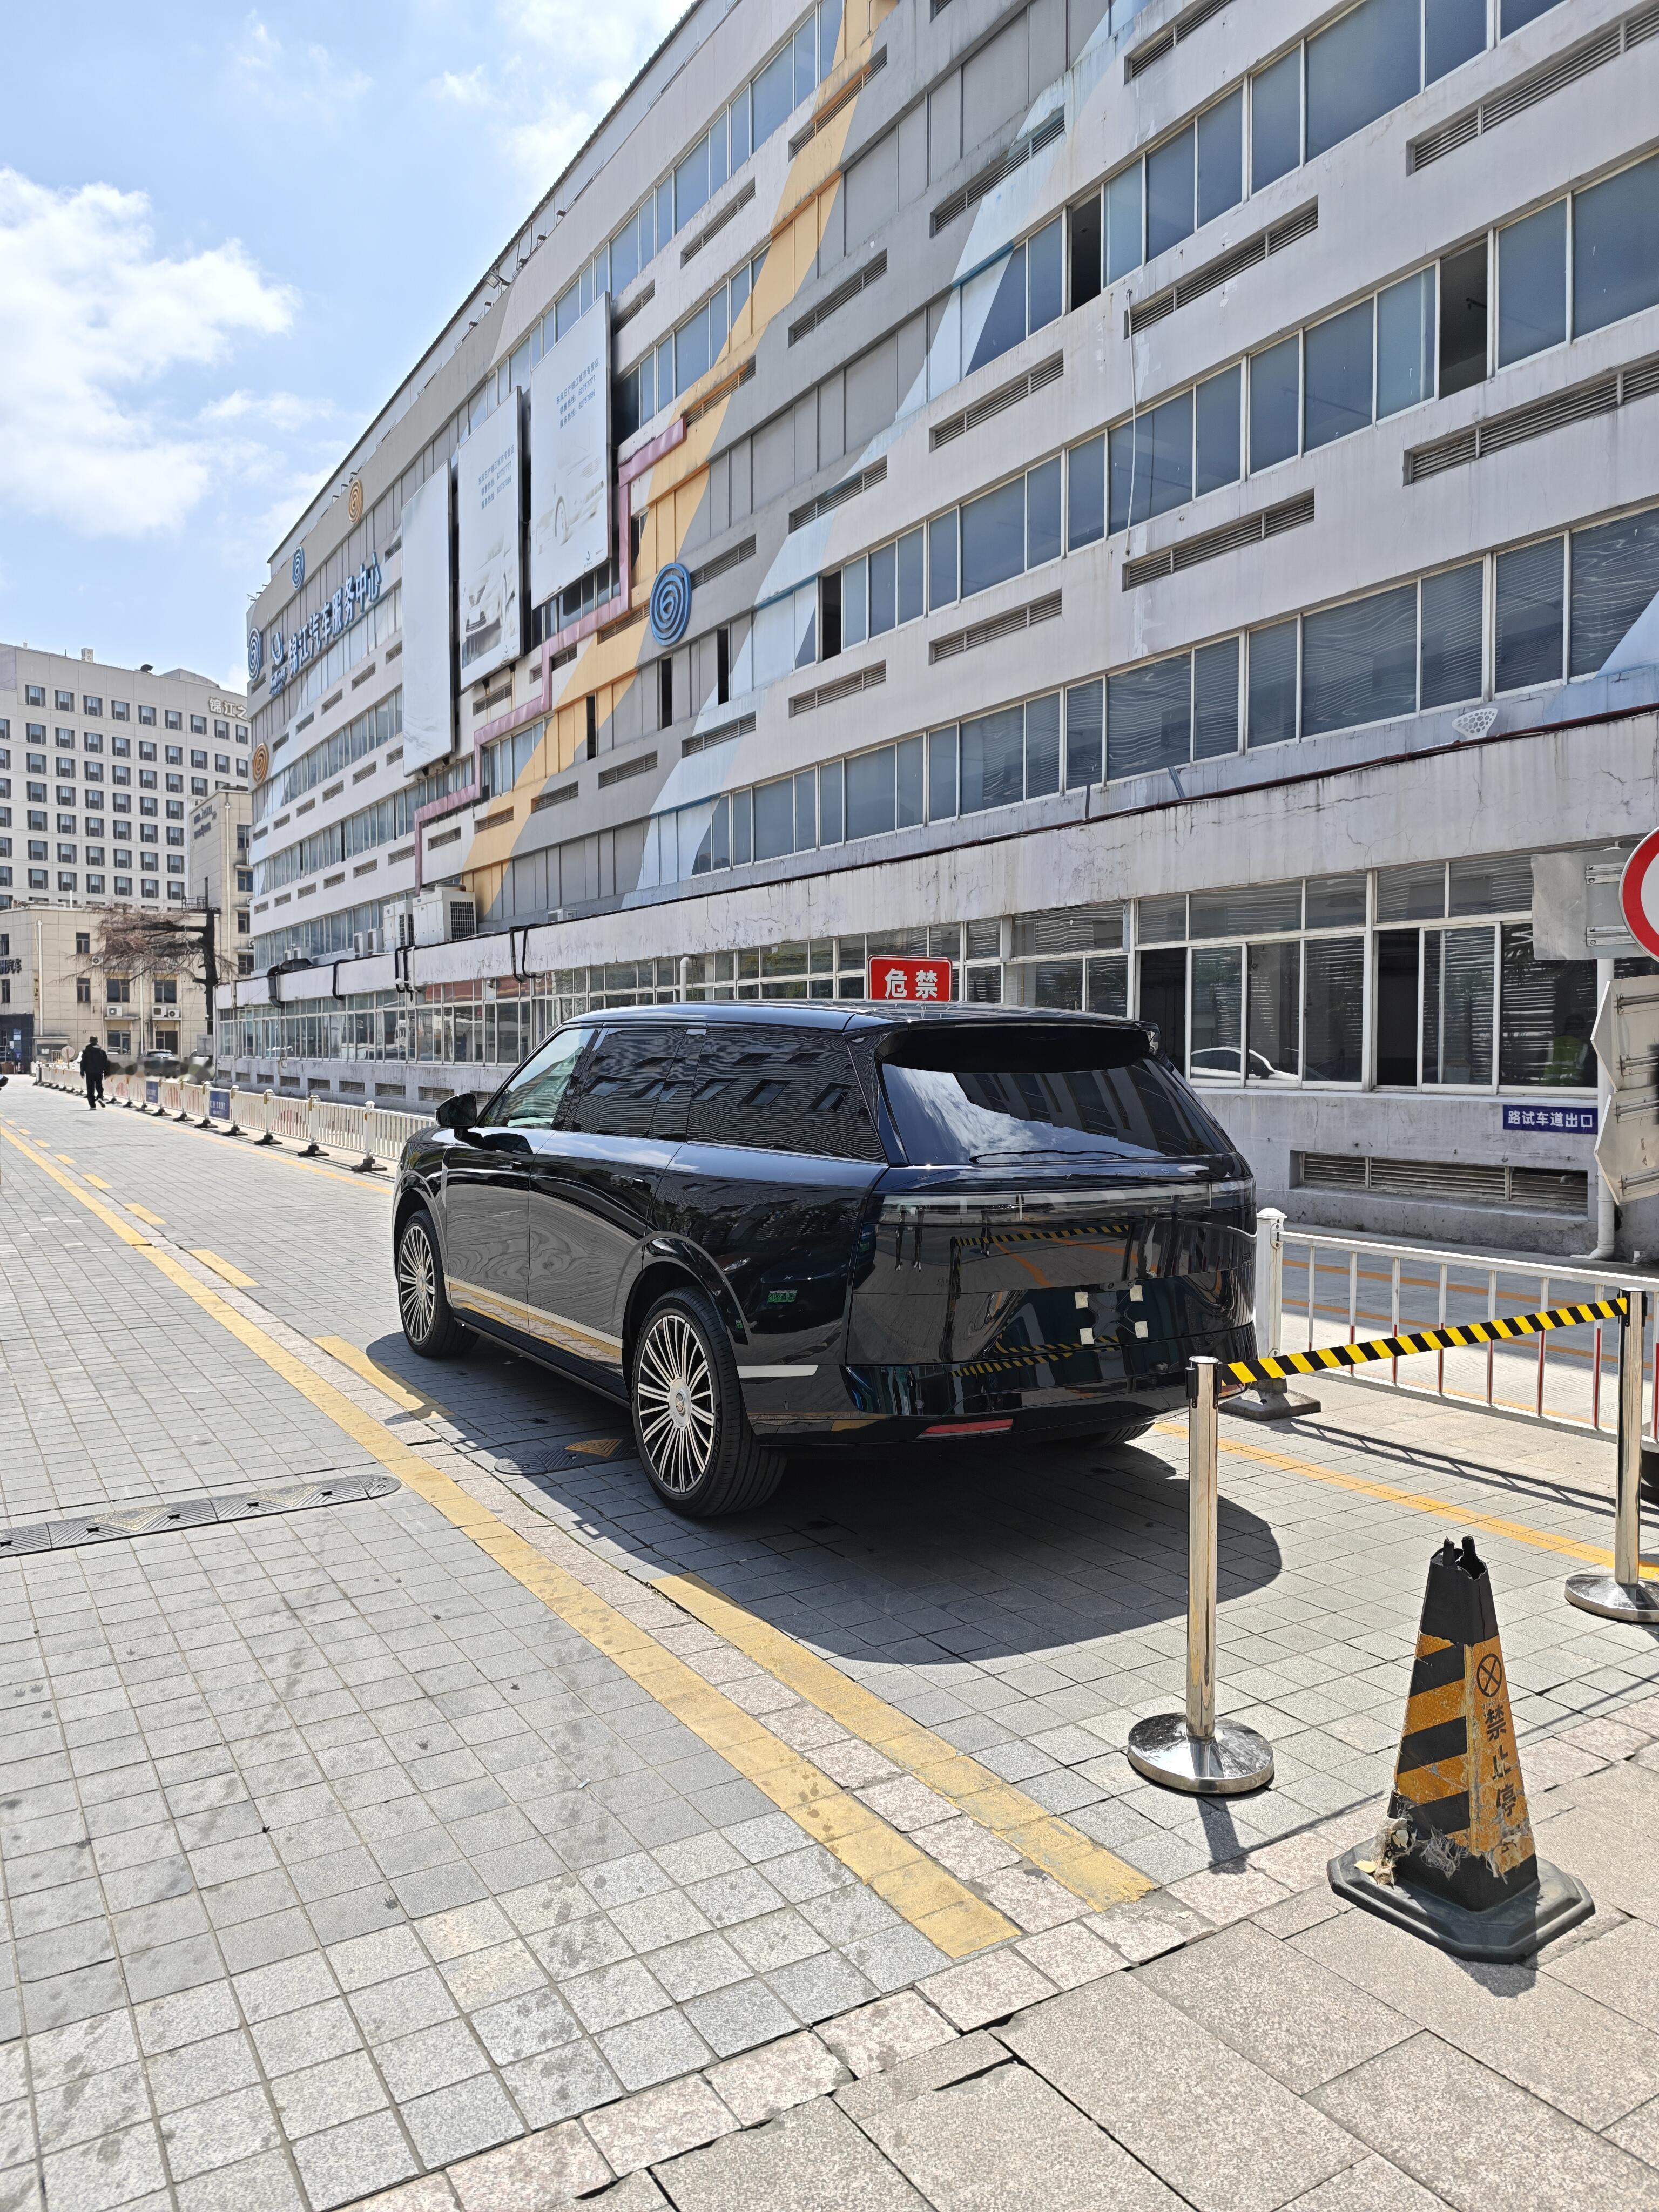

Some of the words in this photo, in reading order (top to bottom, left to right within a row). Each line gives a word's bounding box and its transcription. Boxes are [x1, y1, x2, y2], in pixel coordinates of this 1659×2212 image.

[288, 551, 382, 677] 锦江汽车服务中心
[208, 696, 249, 722] 锦江之
[1507, 1110, 1593, 1128] 路试车道出口
